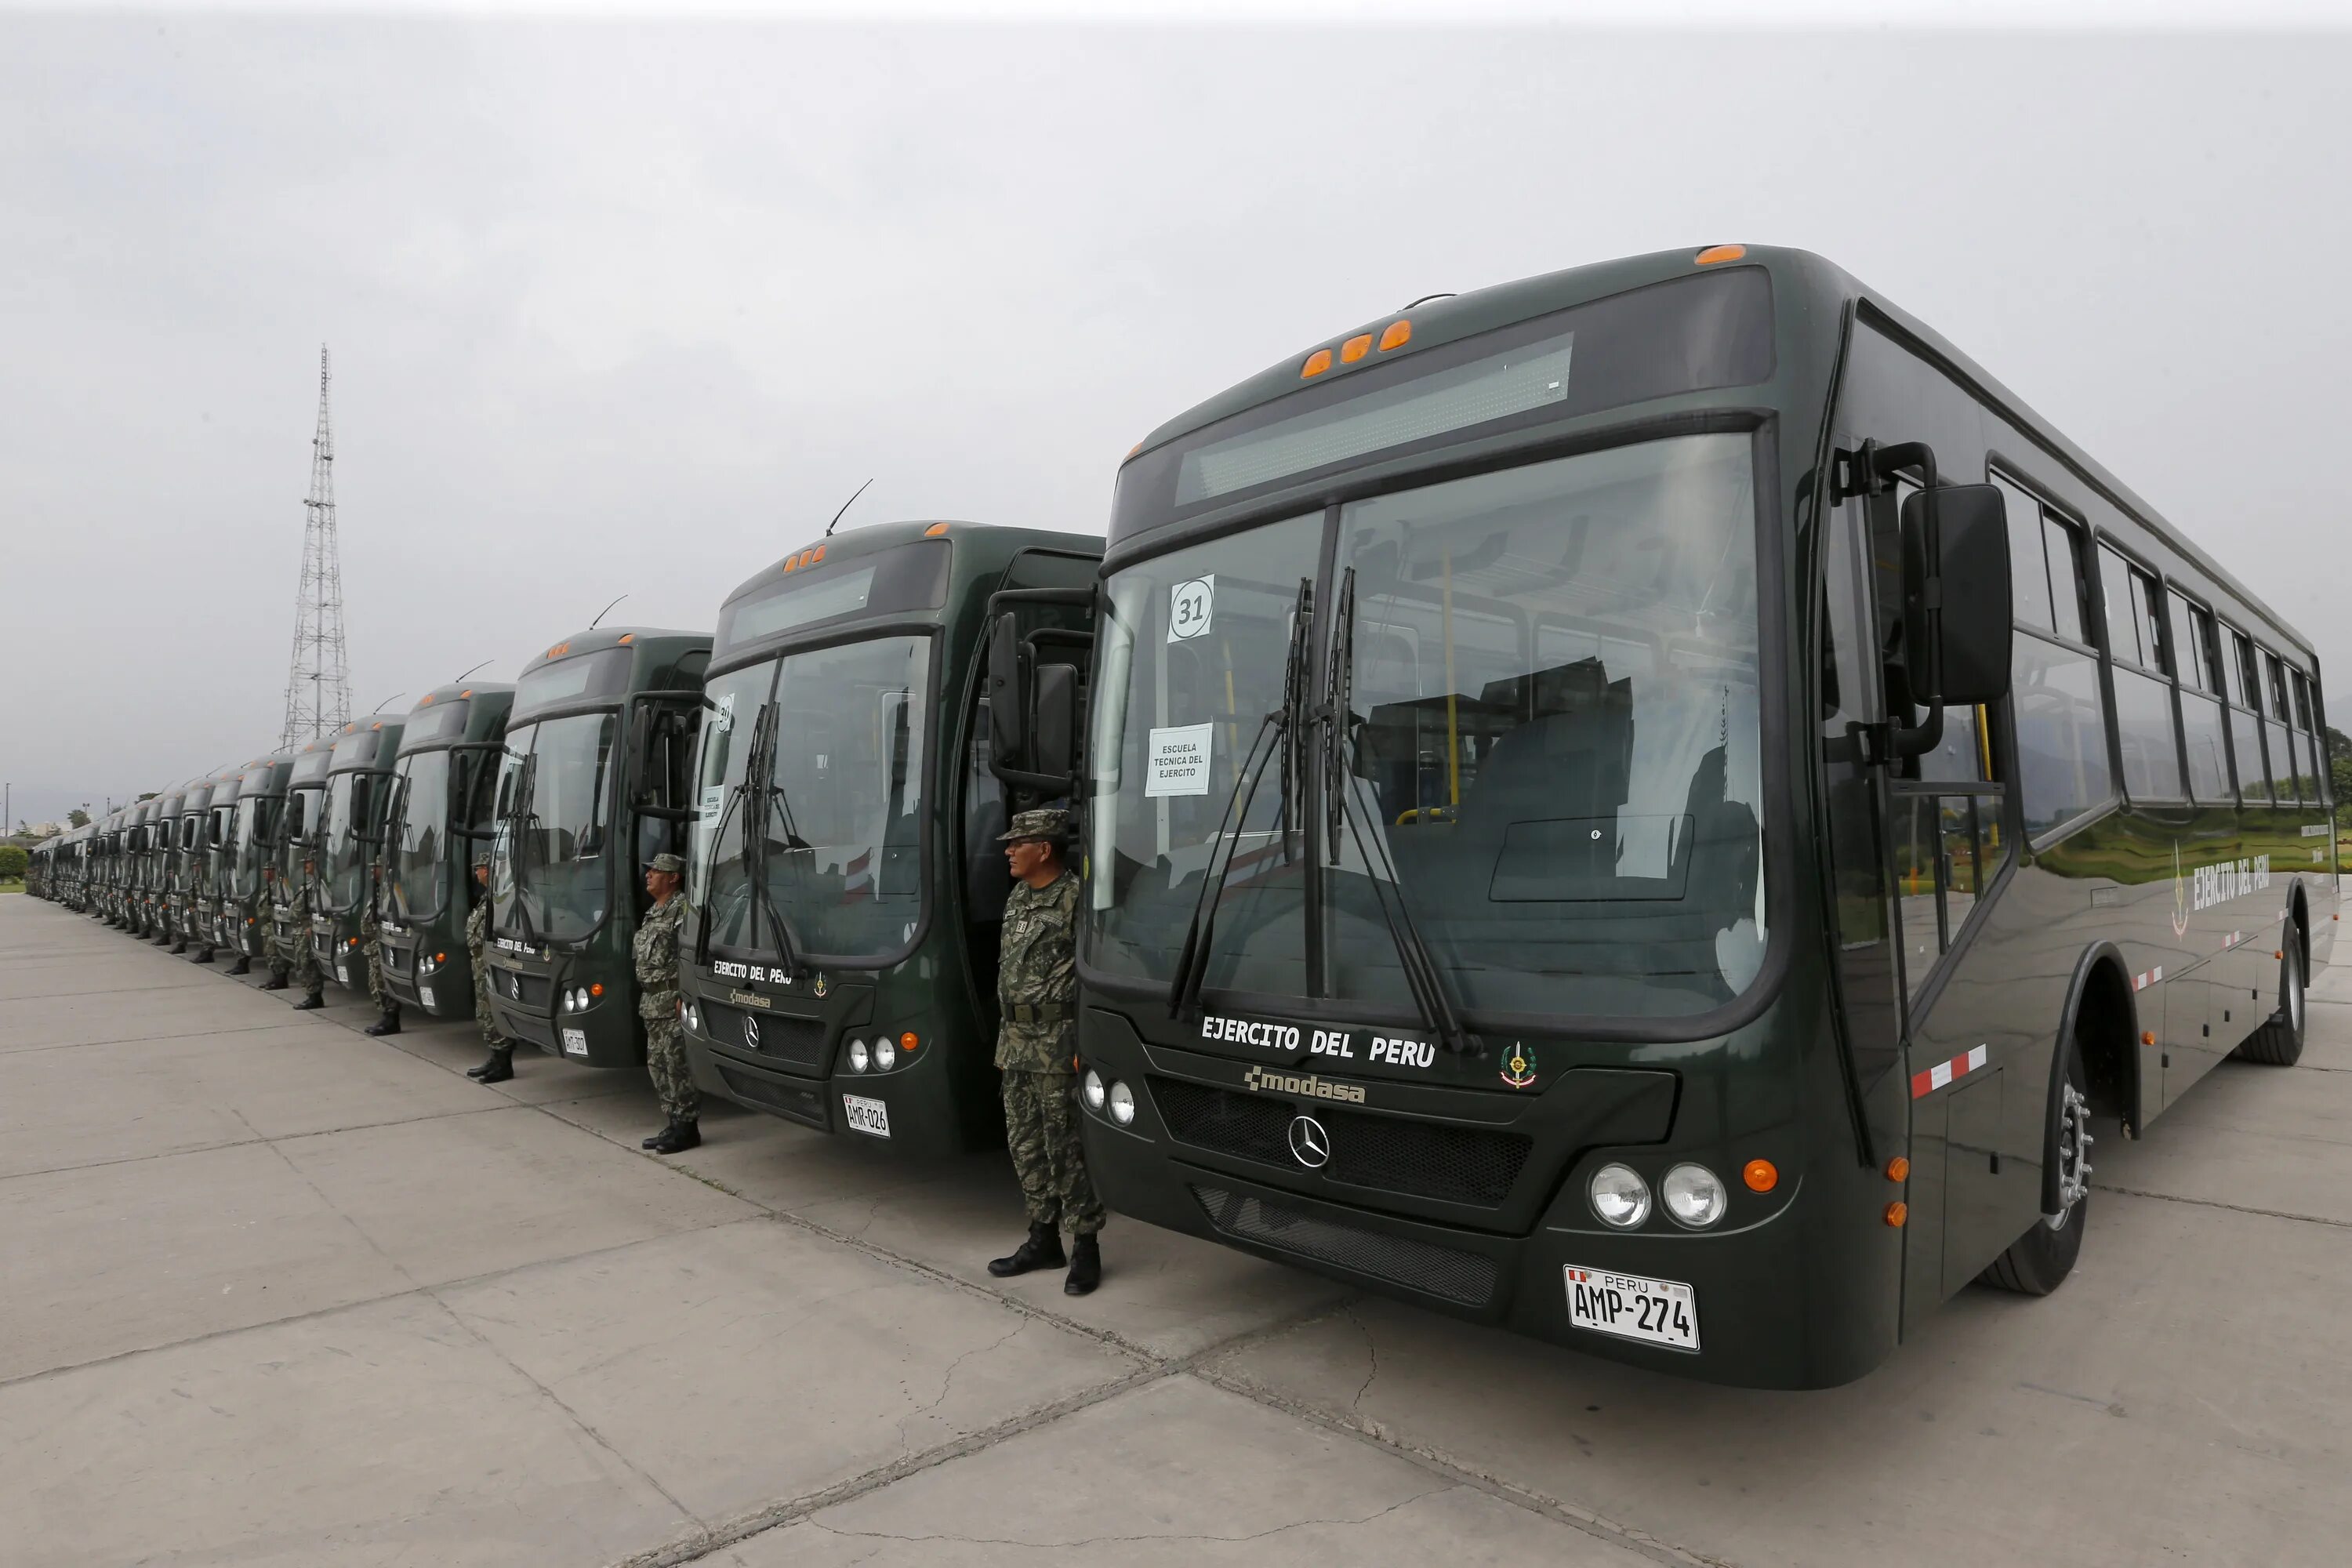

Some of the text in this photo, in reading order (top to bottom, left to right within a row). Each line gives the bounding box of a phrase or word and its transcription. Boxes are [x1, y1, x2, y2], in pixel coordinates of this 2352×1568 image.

[1178, 596, 1203, 624] 31
[1163, 743, 1196, 753] ESCUELA
[1154, 755, 1203, 766] TECNICA DEL
[1160, 768, 1196, 778] EJERCITO
[2194, 854, 2270, 911] EJERCITO DEL PERU
[714, 960, 747, 978] EJERCITO
[750, 965, 765, 982] DEL
[735, 993, 771, 1008] modasa
[1202, 1016, 1436, 1068] EJERCITO DEL PERU
[1260, 1072, 1366, 1104] modasa
[857, 1099, 871, 1109] PERU
[848, 1105, 887, 1131] AMR-026
[1605, 1276, 1649, 1294] PERU
[1575, 1283, 1690, 1337] AMP-274
